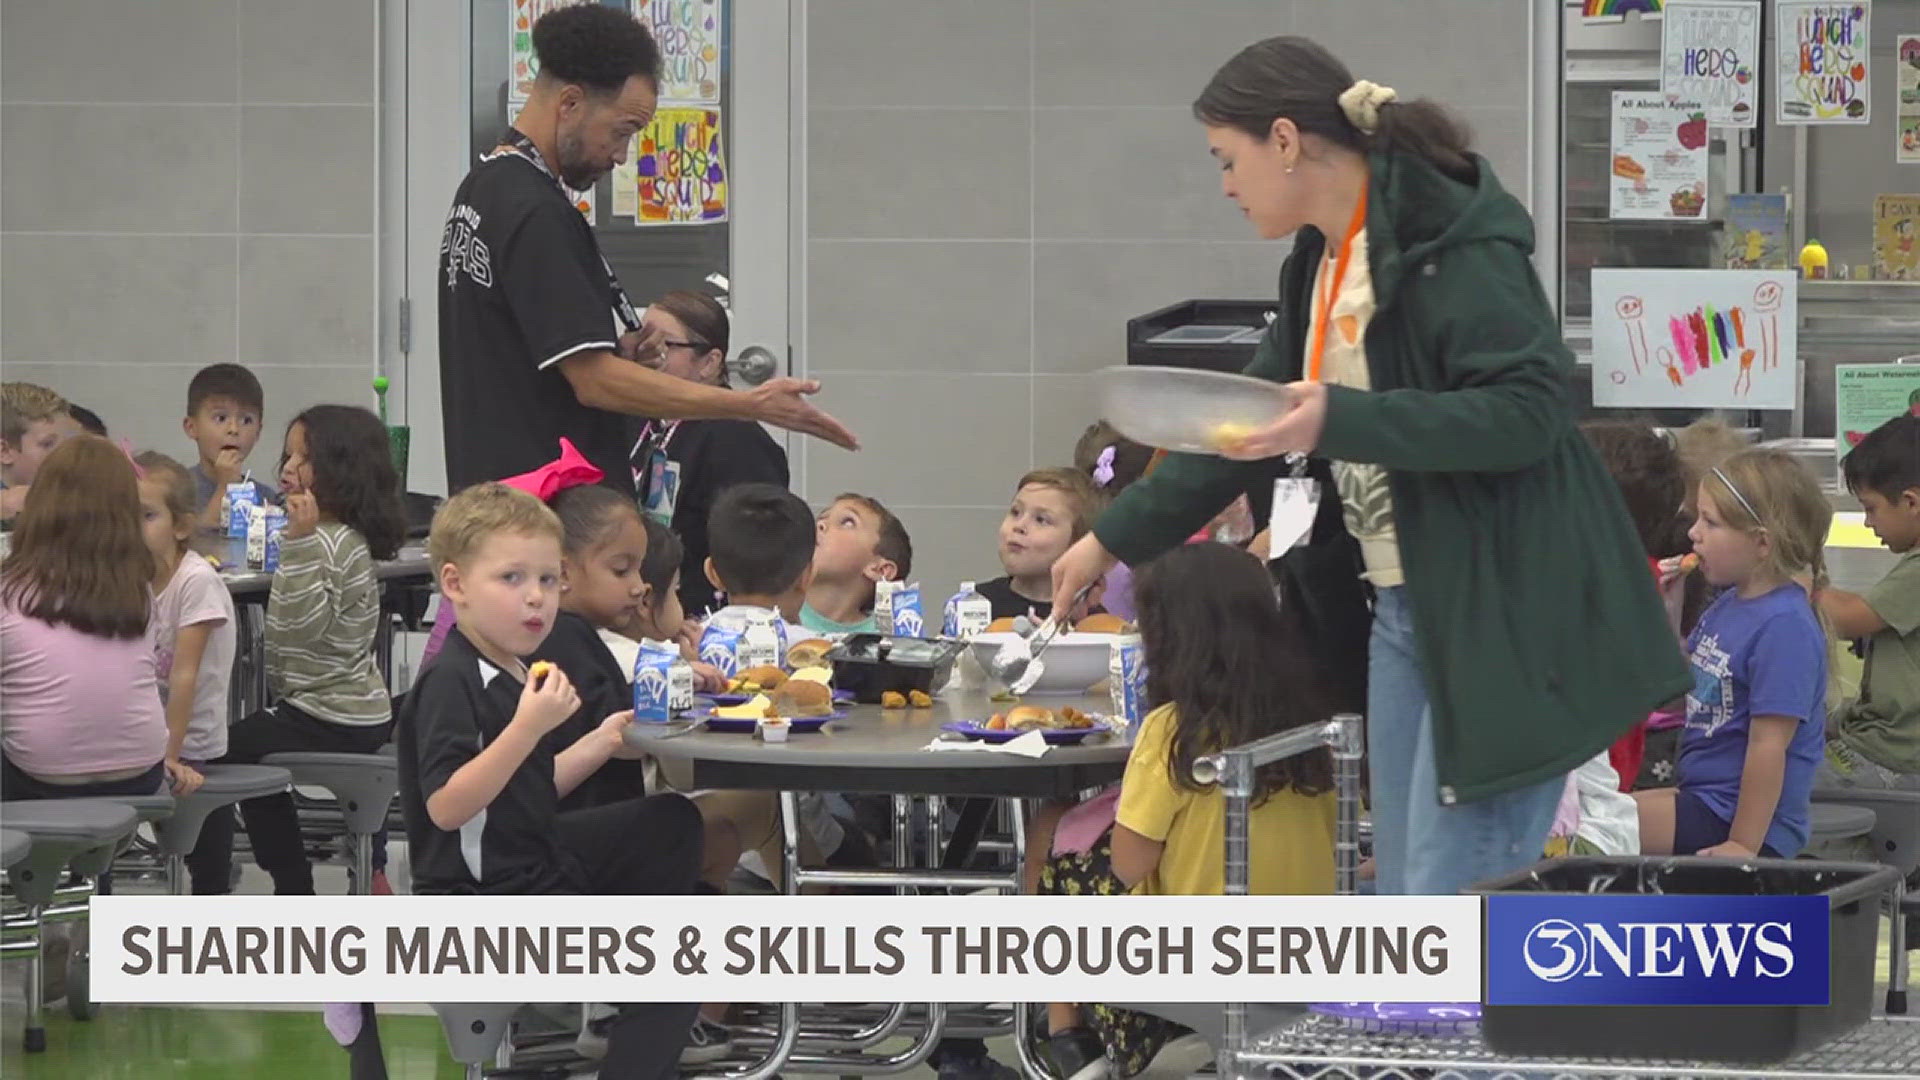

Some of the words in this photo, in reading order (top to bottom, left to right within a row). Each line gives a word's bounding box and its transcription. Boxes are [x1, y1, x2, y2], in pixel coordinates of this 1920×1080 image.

[1621, 100, 1633, 108] All
[1637, 99, 1665, 108] About
[1669, 100, 1701, 111] Apples
